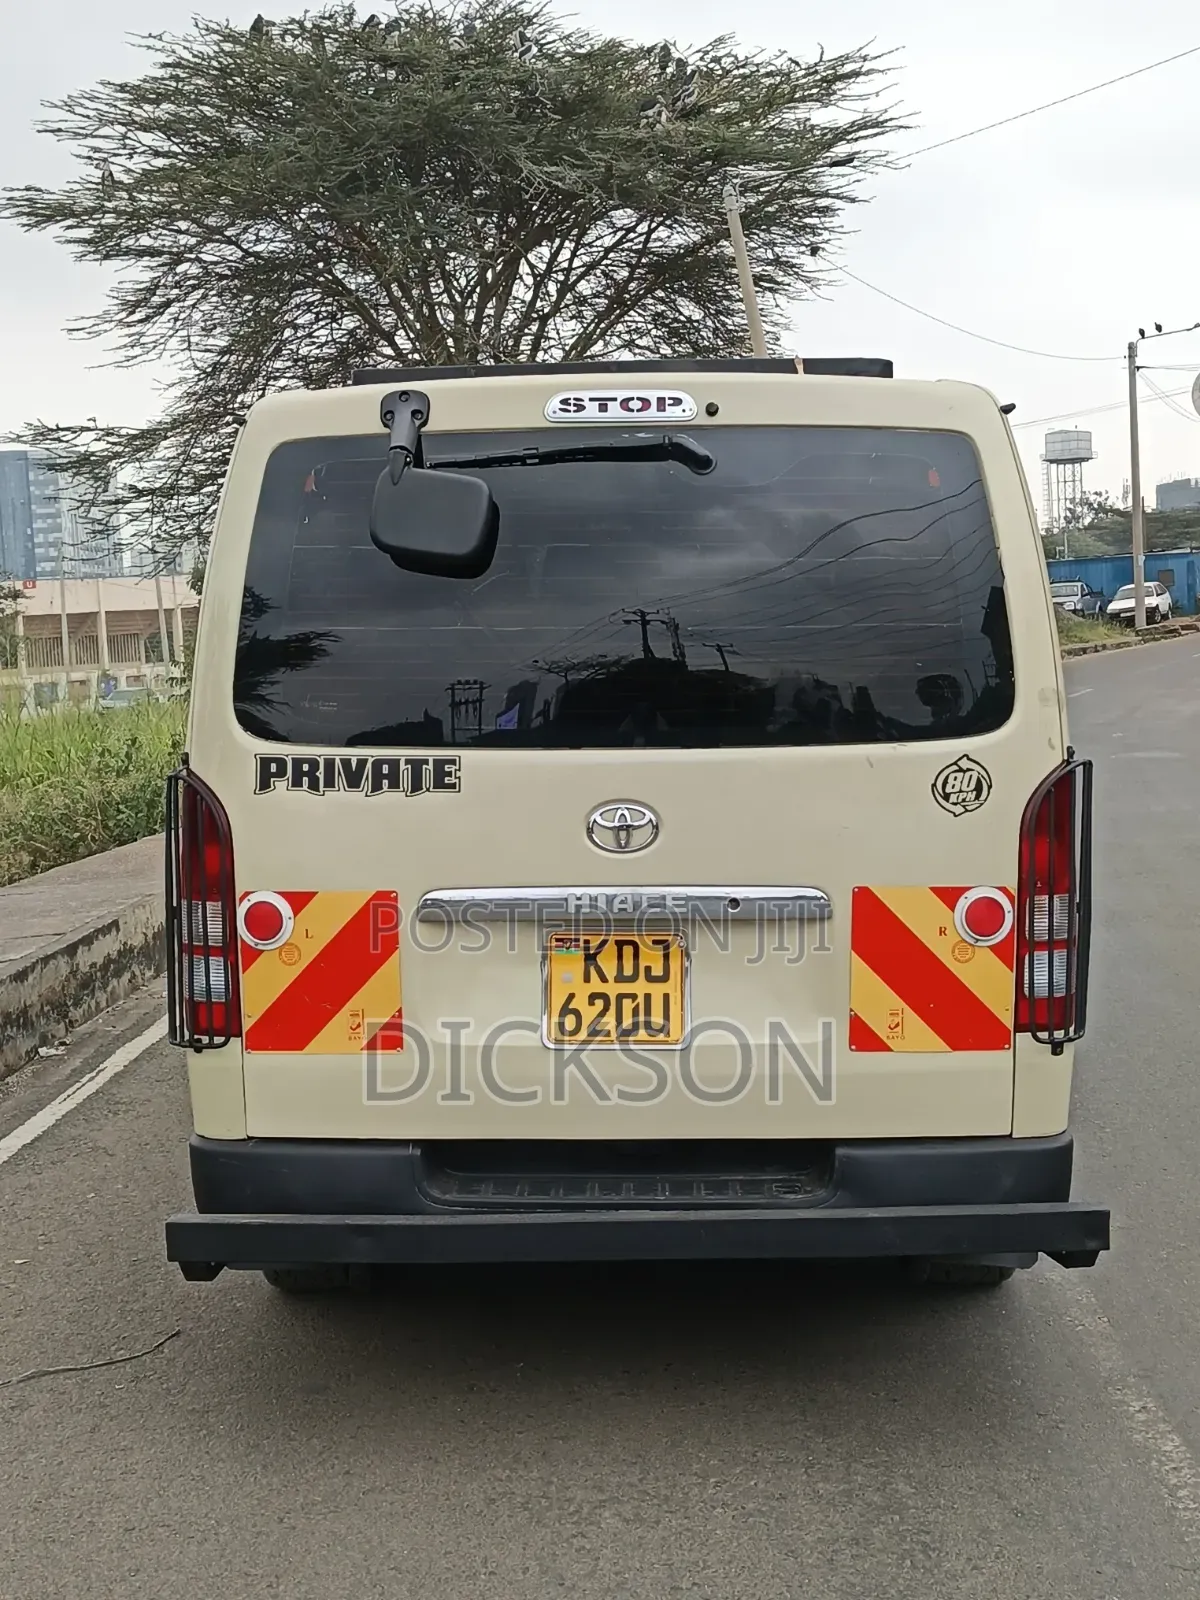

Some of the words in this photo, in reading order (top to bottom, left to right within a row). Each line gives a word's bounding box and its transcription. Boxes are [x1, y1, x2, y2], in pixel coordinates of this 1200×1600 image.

[558, 396, 683, 413] STOP
[254, 753, 461, 797] PRIVATE
[945, 770, 979, 793] 80
[949, 791, 977, 803] KPH
[938, 926, 948, 937] R
[583, 939, 671, 984] KDJ
[558, 992, 671, 1038] 620U
